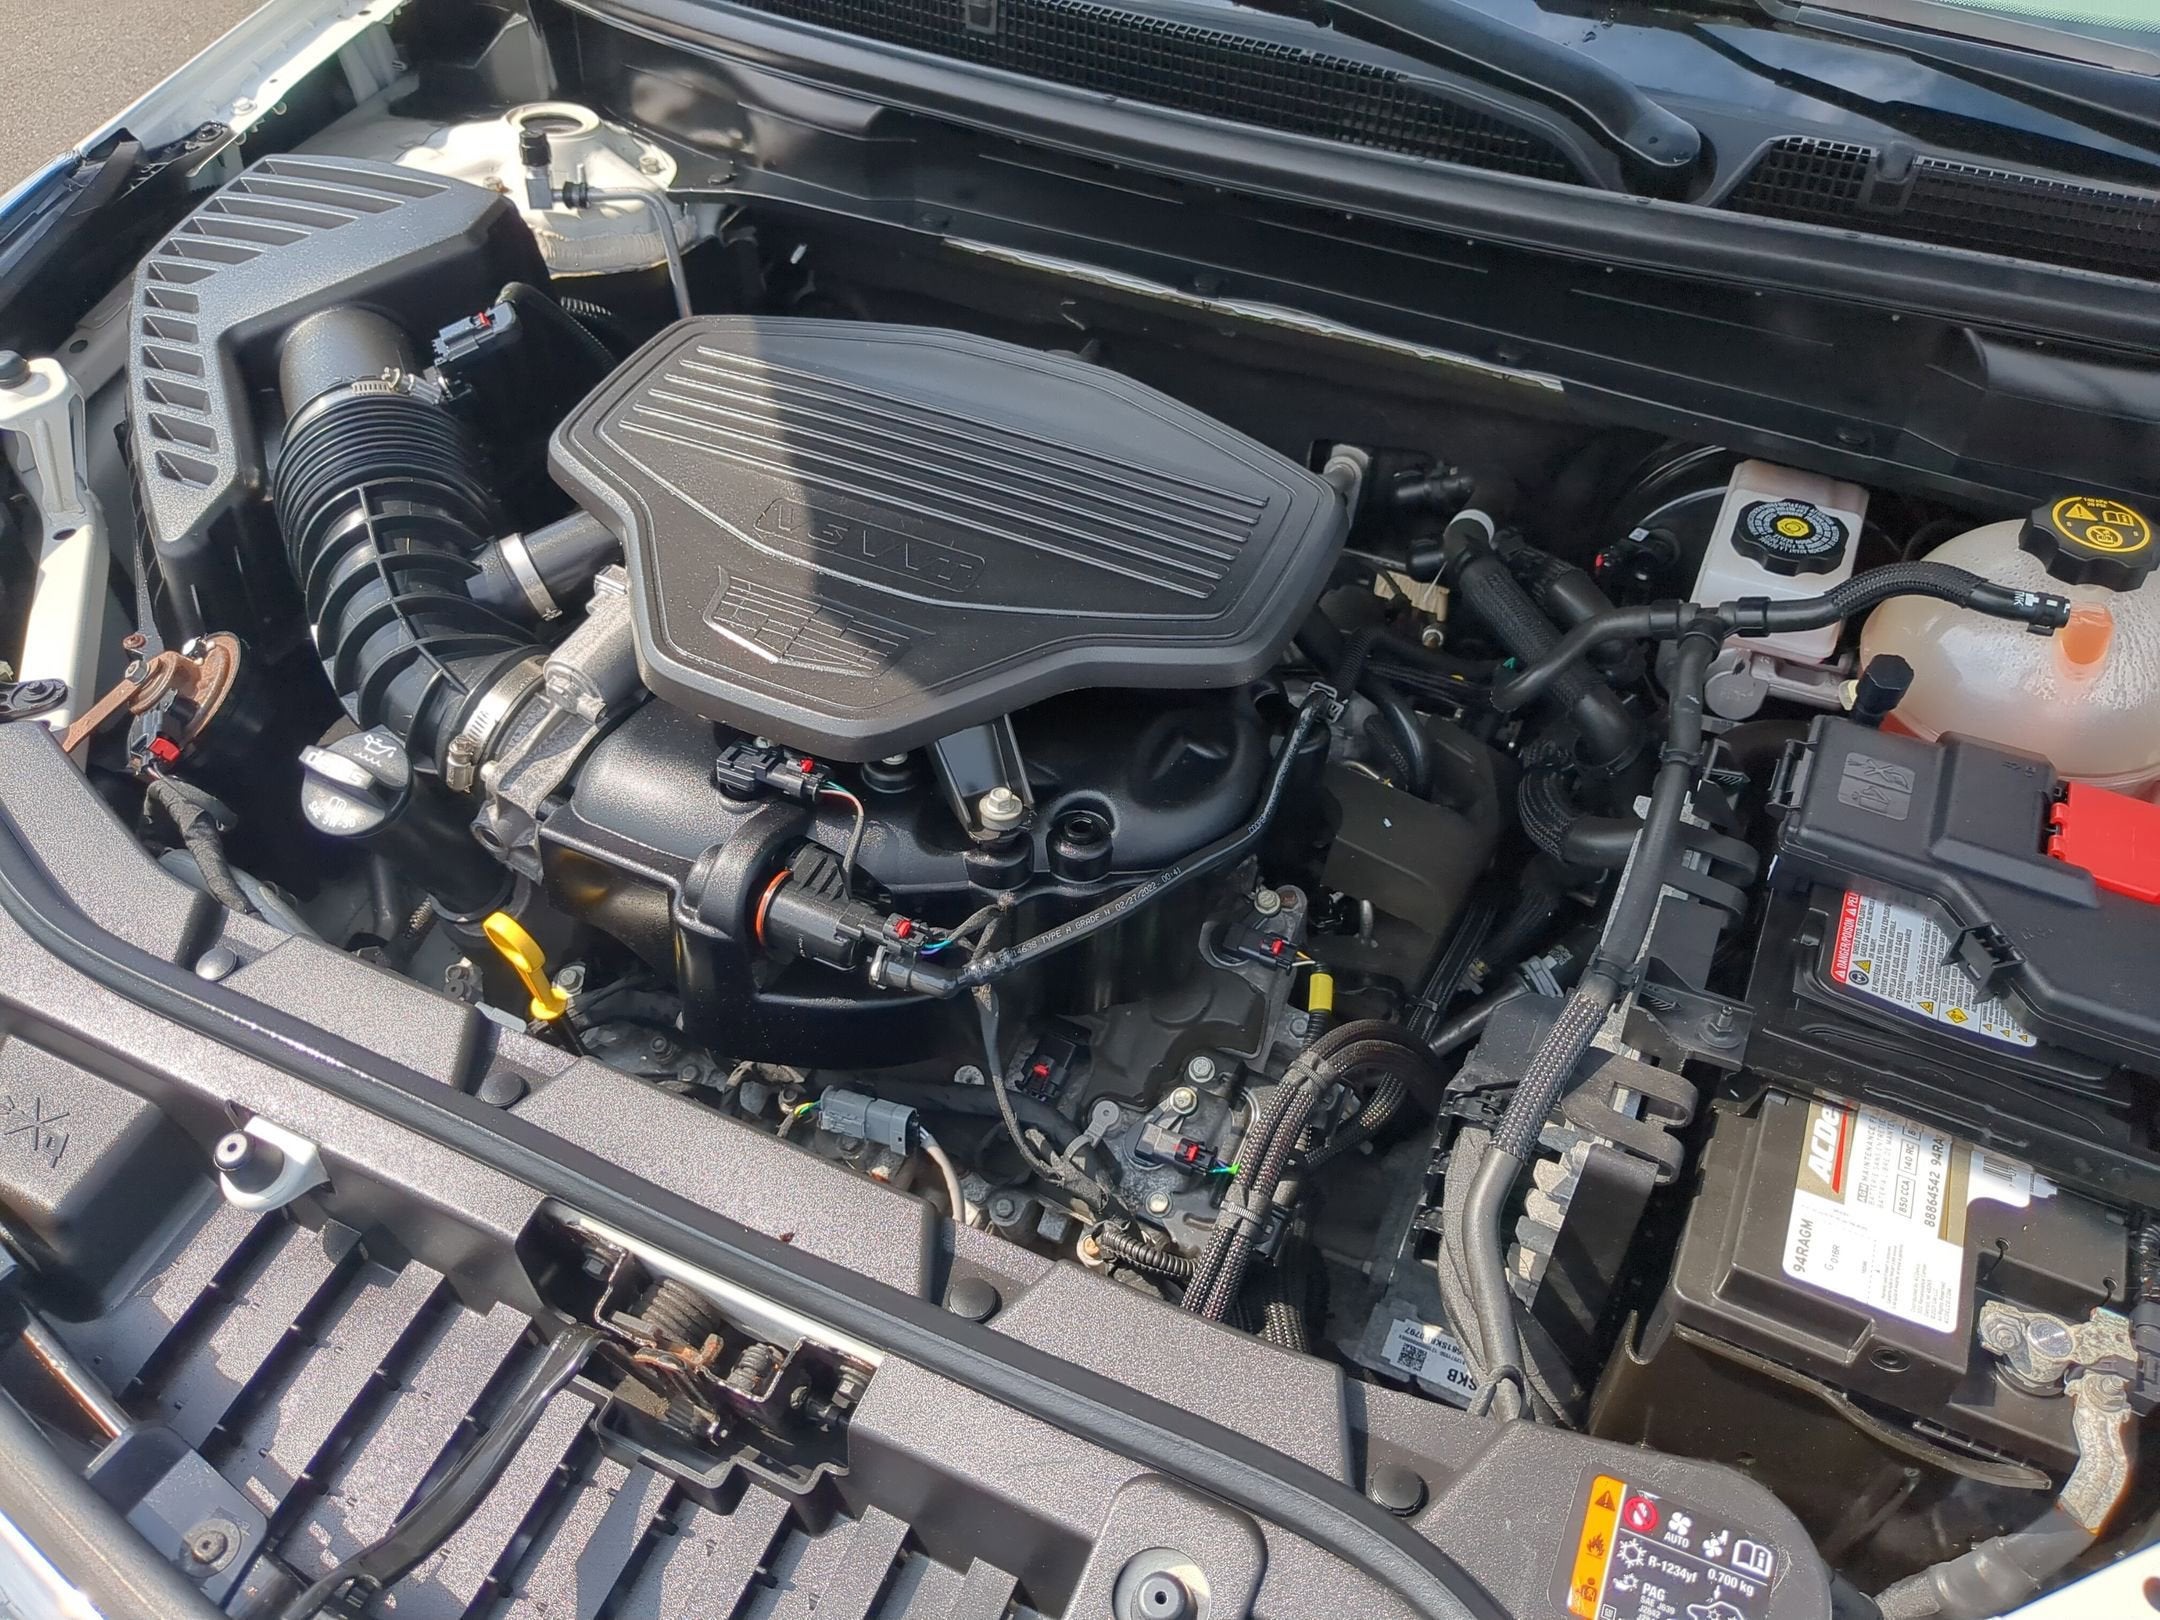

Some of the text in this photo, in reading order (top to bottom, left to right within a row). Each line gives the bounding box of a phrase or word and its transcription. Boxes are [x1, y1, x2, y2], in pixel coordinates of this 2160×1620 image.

[1836, 916, 1855, 969] DANGER/POISON
[1807, 1104, 1839, 1184] ACDe
[1861, 1124, 1875, 1182] MAINTENANCE
[1875, 1117, 1886, 1151] ENTRETIE
[1903, 1155, 1913, 1171] 140
[1897, 1178, 1910, 1213] 850 CCA
[1923, 1169, 1941, 1228] 88864542
[1792, 1216, 1813, 1274] 94RAGM
[1664, 1531, 1690, 1548] AUTO
[1642, 1582, 1666, 1601] PAG
[1648, 1555, 1754, 1597] R-1234yf 0.700 kg
[1640, 1595, 1655, 1607] SAE
